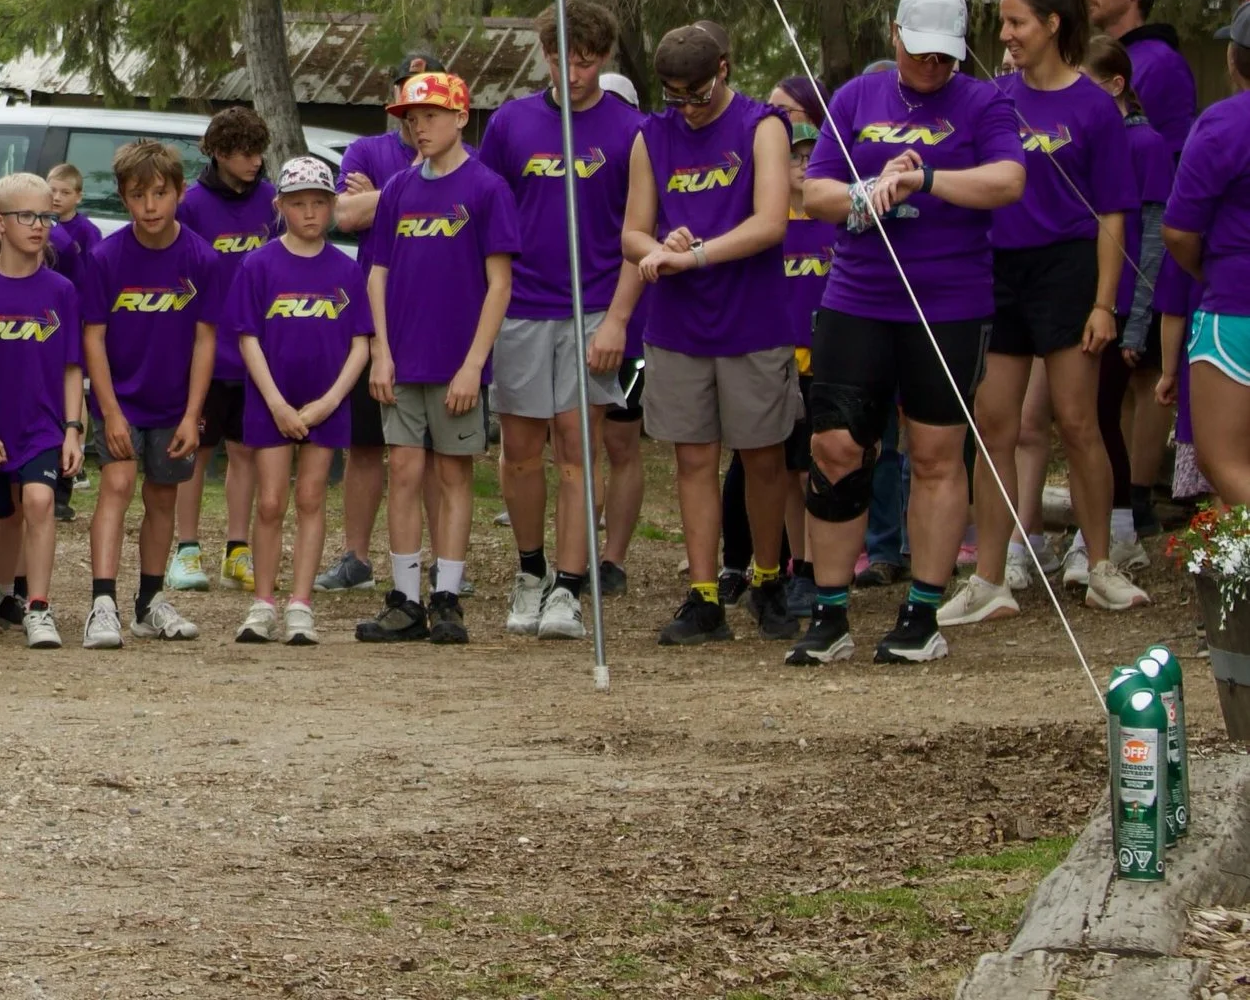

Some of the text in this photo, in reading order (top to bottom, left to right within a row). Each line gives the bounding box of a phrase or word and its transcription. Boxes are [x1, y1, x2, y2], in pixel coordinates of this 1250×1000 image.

[857, 124, 954, 146] RUN
[1020, 132, 1071, 154] UN
[667, 164, 742, 193] RUN
[395, 218, 470, 237] RUN
[213, 235, 268, 254] RUN
[783, 258, 832, 277] UN
[111, 293, 197, 312] RUN
[265, 299, 350, 319] RUN
[1122, 745, 1150, 760] OFF!
